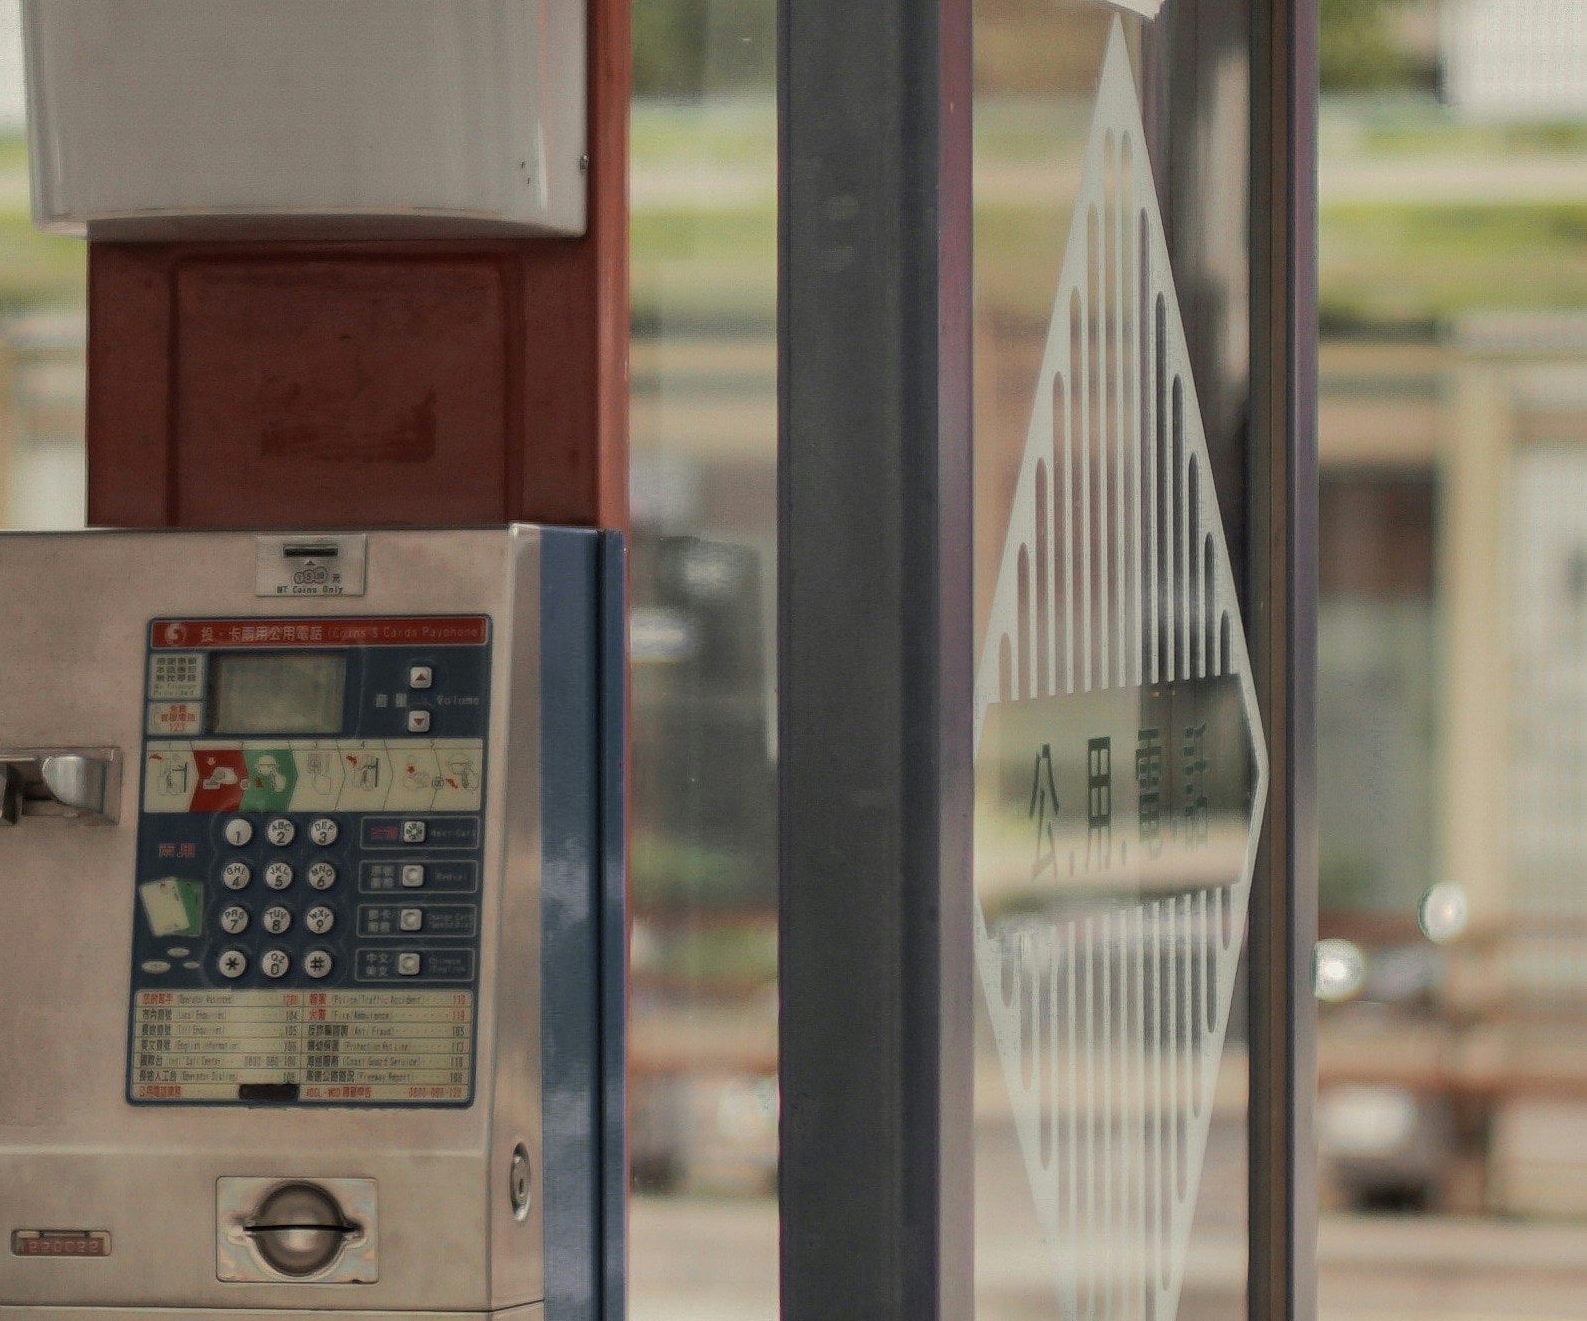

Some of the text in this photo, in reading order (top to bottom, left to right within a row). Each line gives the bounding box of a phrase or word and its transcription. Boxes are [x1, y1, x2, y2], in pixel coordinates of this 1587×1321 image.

[292, 585, 318, 595] Coins
[322, 584, 344, 596] Only
[271, 821, 291, 832] ABC
[314, 821, 334, 833] DEF
[234, 830, 241, 845] 1
[276, 831, 286, 844] 2
[318, 831, 328, 845] 3
[226, 864, 246, 876] GHI
[269, 865, 289, 876] JKL
[310, 864, 333, 877] MNO
[231, 875, 240, 888] 4
[274, 875, 283, 888] 5
[316, 875, 326, 888] 6
[266, 908, 287, 920] TUV
[309, 908, 331, 920] WXY
[230, 919, 238, 932] 7
[272, 919, 281, 932] 8
[316, 919, 325, 932] 9
[270, 952, 286, 965] QZ
[365, 953, 390, 965] 中文
[270, 963, 280, 977] 0
